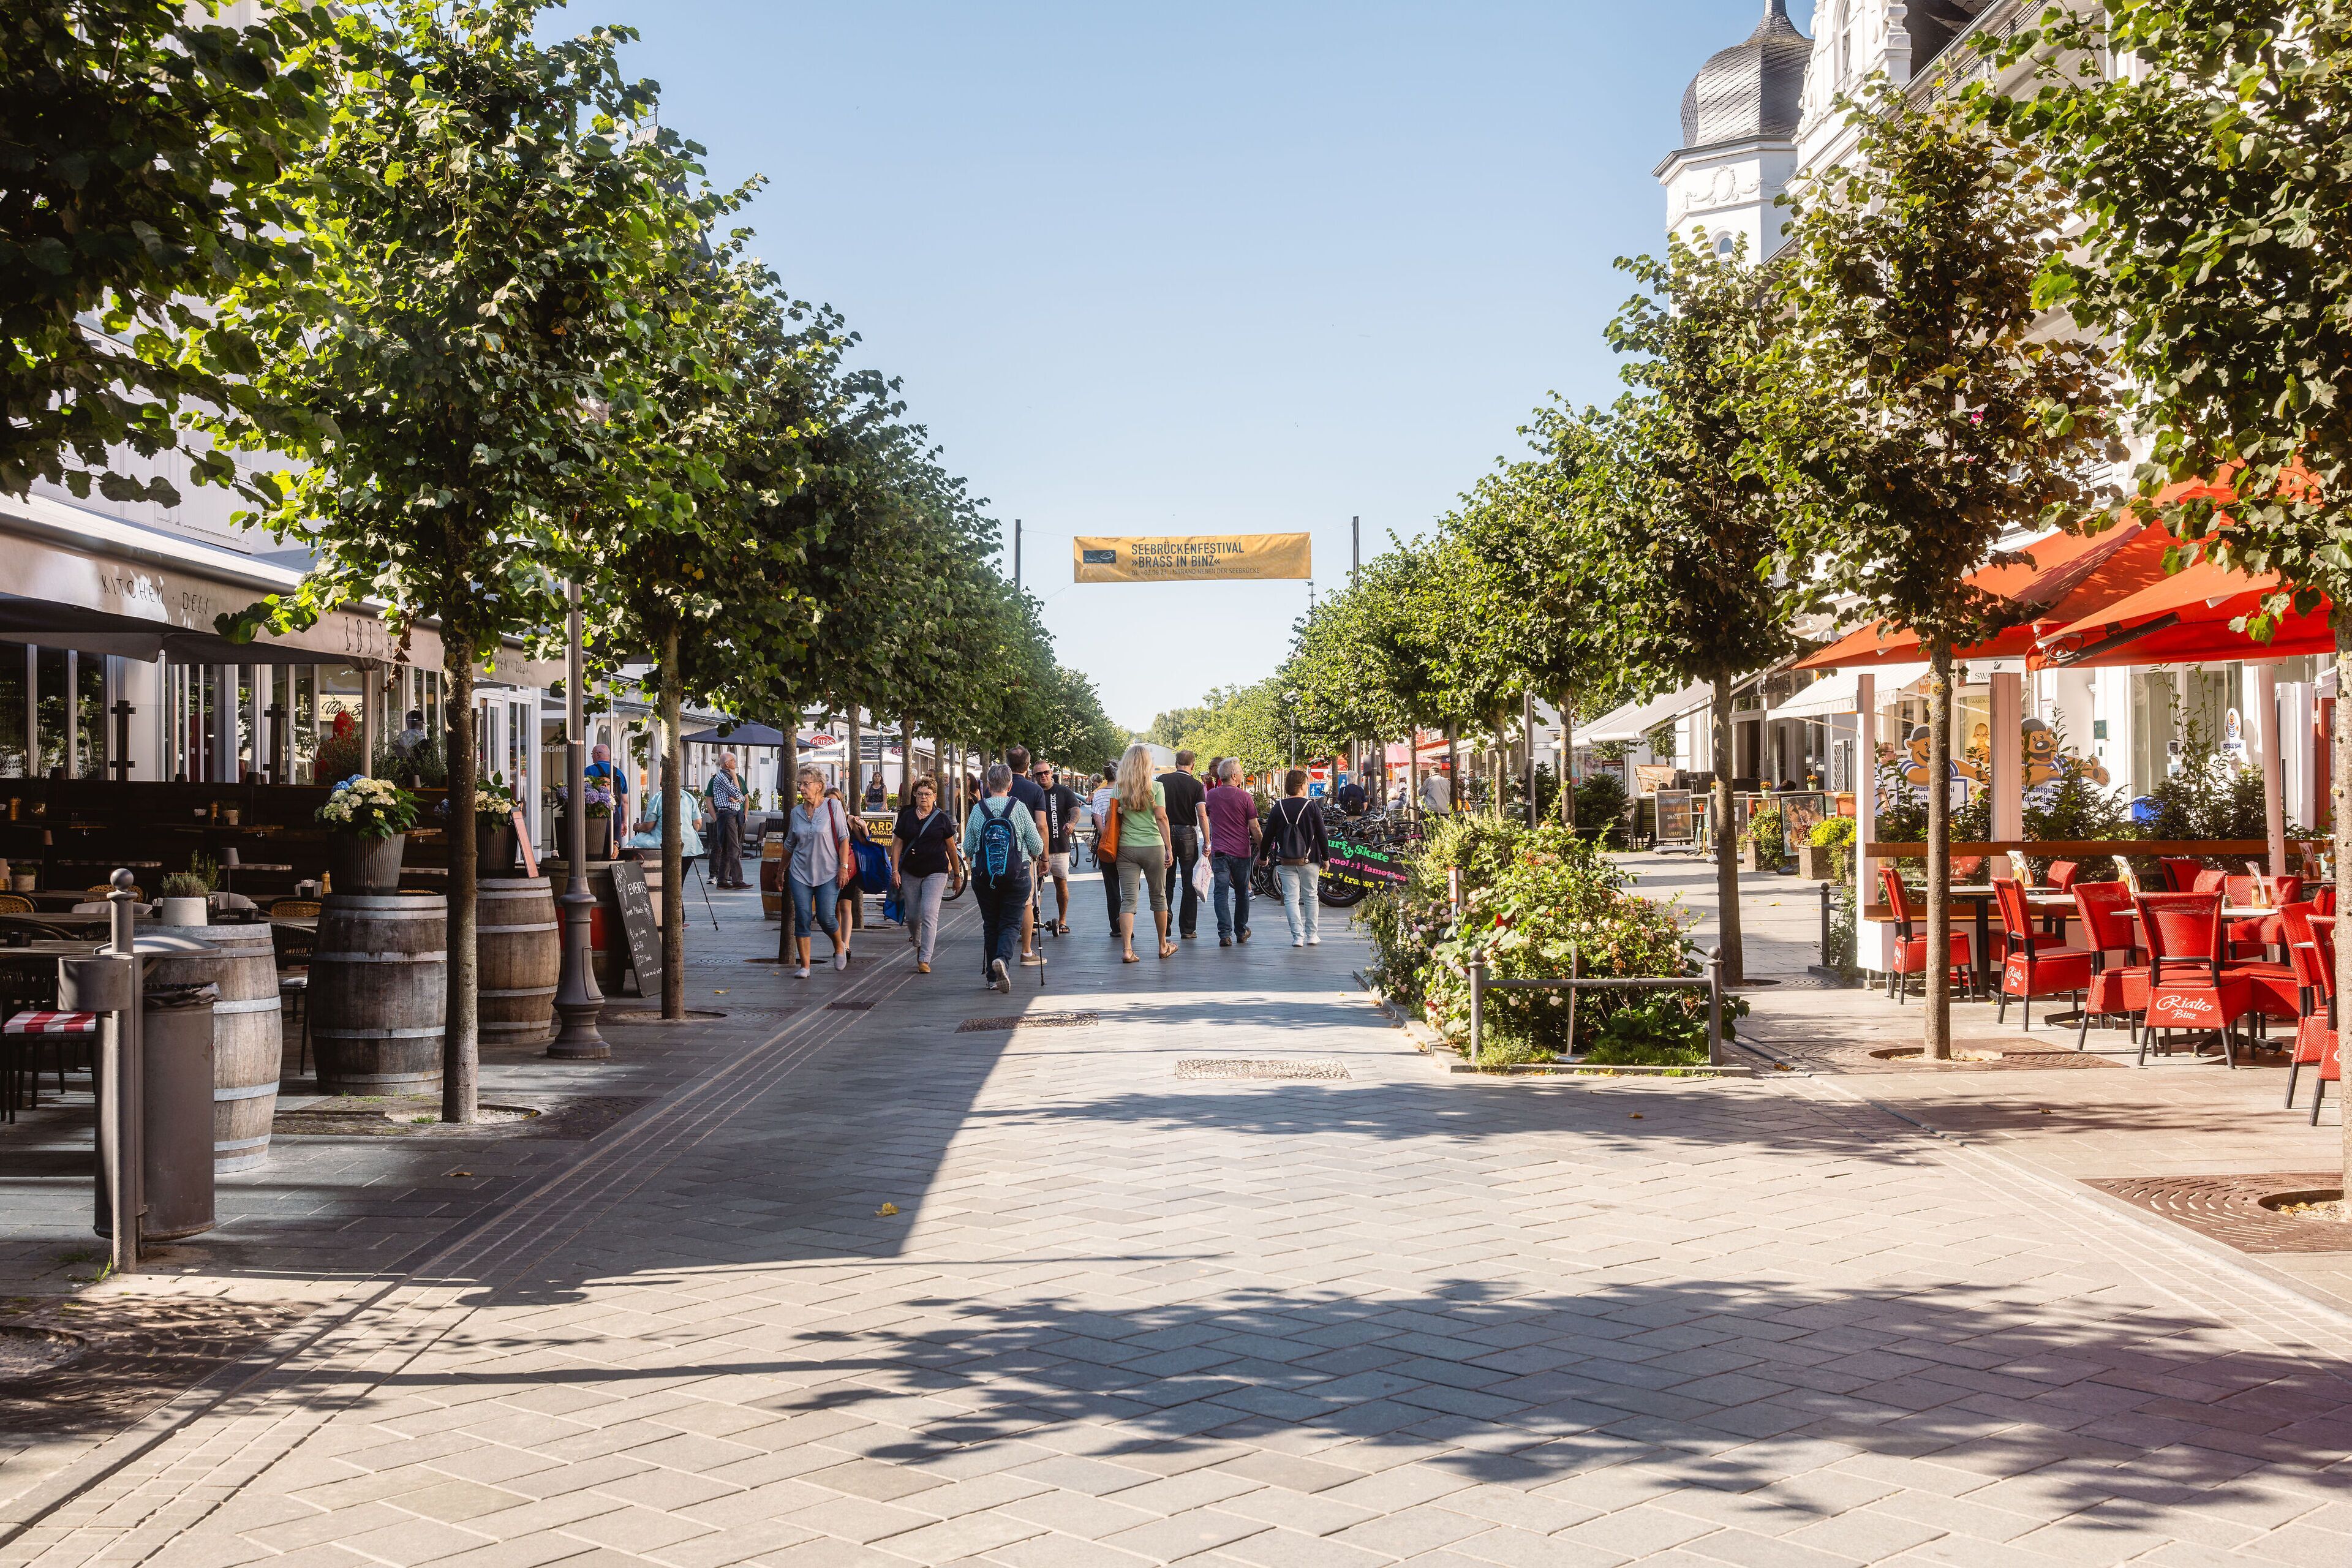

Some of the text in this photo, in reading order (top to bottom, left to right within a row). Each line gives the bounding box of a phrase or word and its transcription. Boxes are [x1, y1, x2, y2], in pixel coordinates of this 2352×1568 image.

[1131, 541, 1245, 555] SEEBRÜCKENFESTIVAL
[1177, 557, 1187, 567] IN
[1229, 565, 1260, 574] SEEBRÜCKE
[102, 575, 209, 615] KITCHEN DELI
[1327, 839, 1348, 850] urf
[1354, 845, 1389, 862] Skate
[627, 881, 647, 895] EVENTS
[1378, 881, 1385, 889] 7
[2007, 966, 2024, 981] Rialto
[2156, 995, 2214, 1011] Rialto
[2171, 1009, 2197, 1020] Binz
